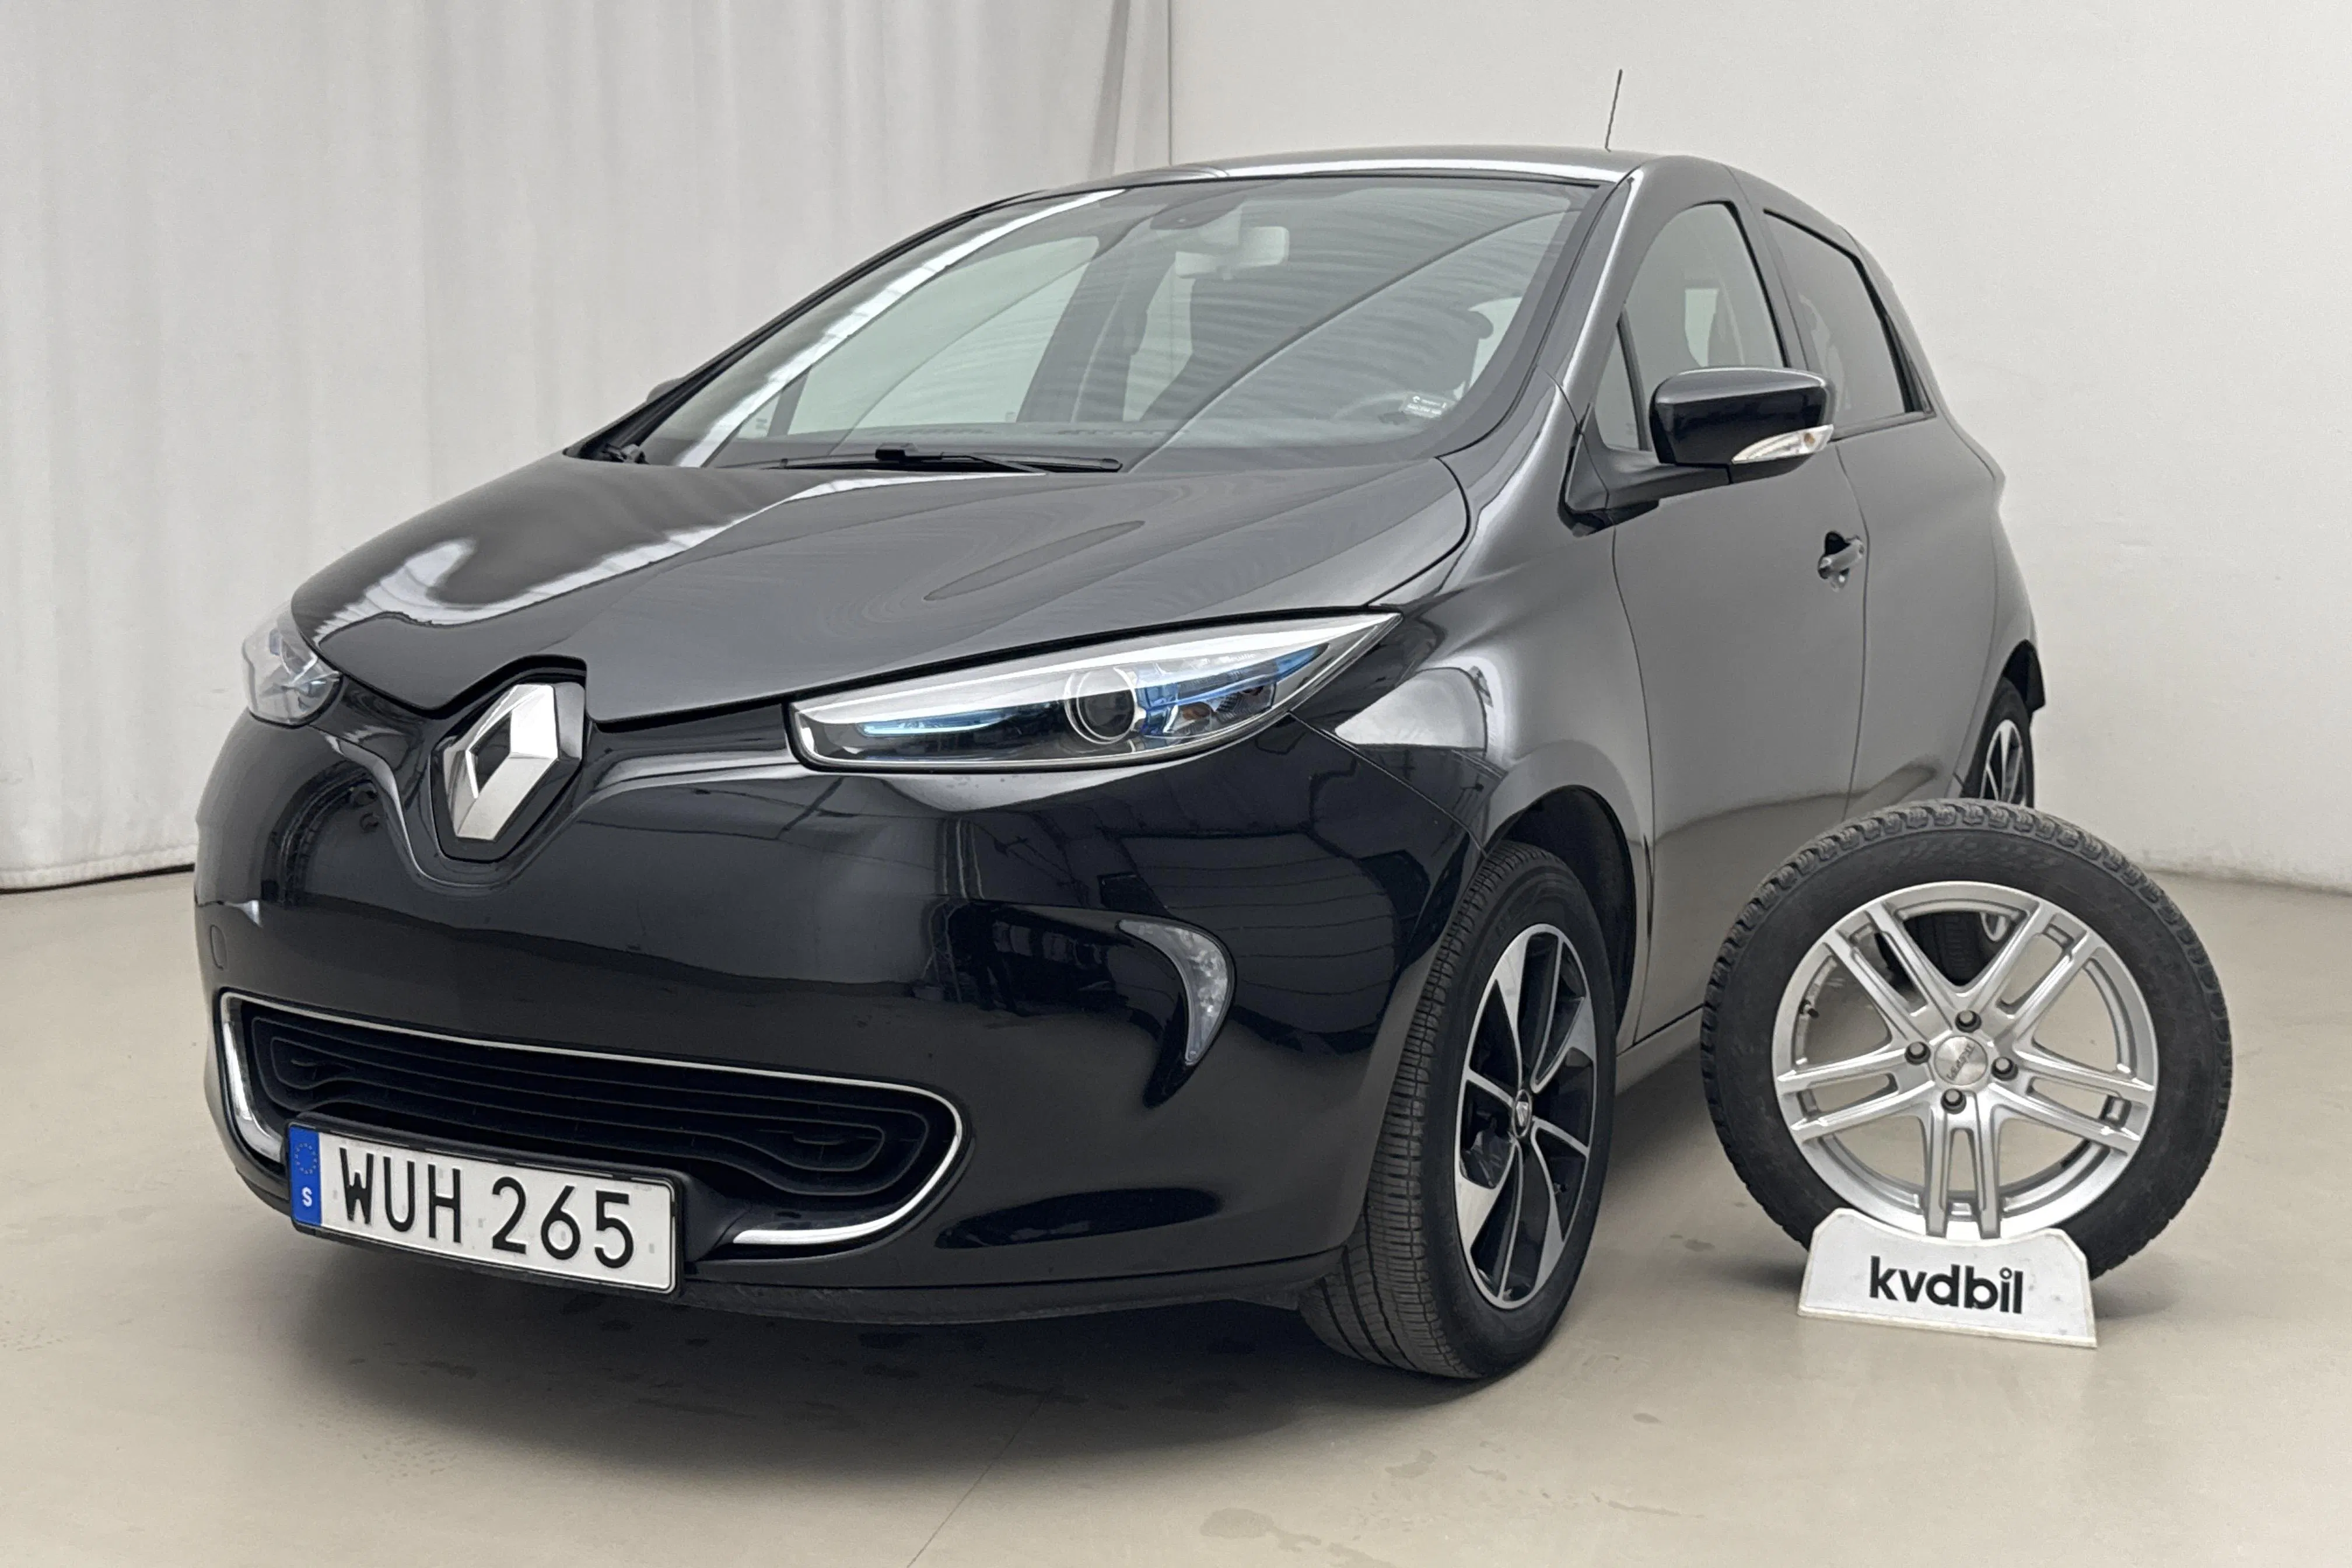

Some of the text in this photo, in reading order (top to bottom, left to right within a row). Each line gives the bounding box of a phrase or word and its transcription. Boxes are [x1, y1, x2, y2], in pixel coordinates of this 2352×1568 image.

[302, 1186, 313, 1207] S
[339, 1147, 635, 1269] WUH 265
[1869, 1255, 2023, 1314] kvdbil
